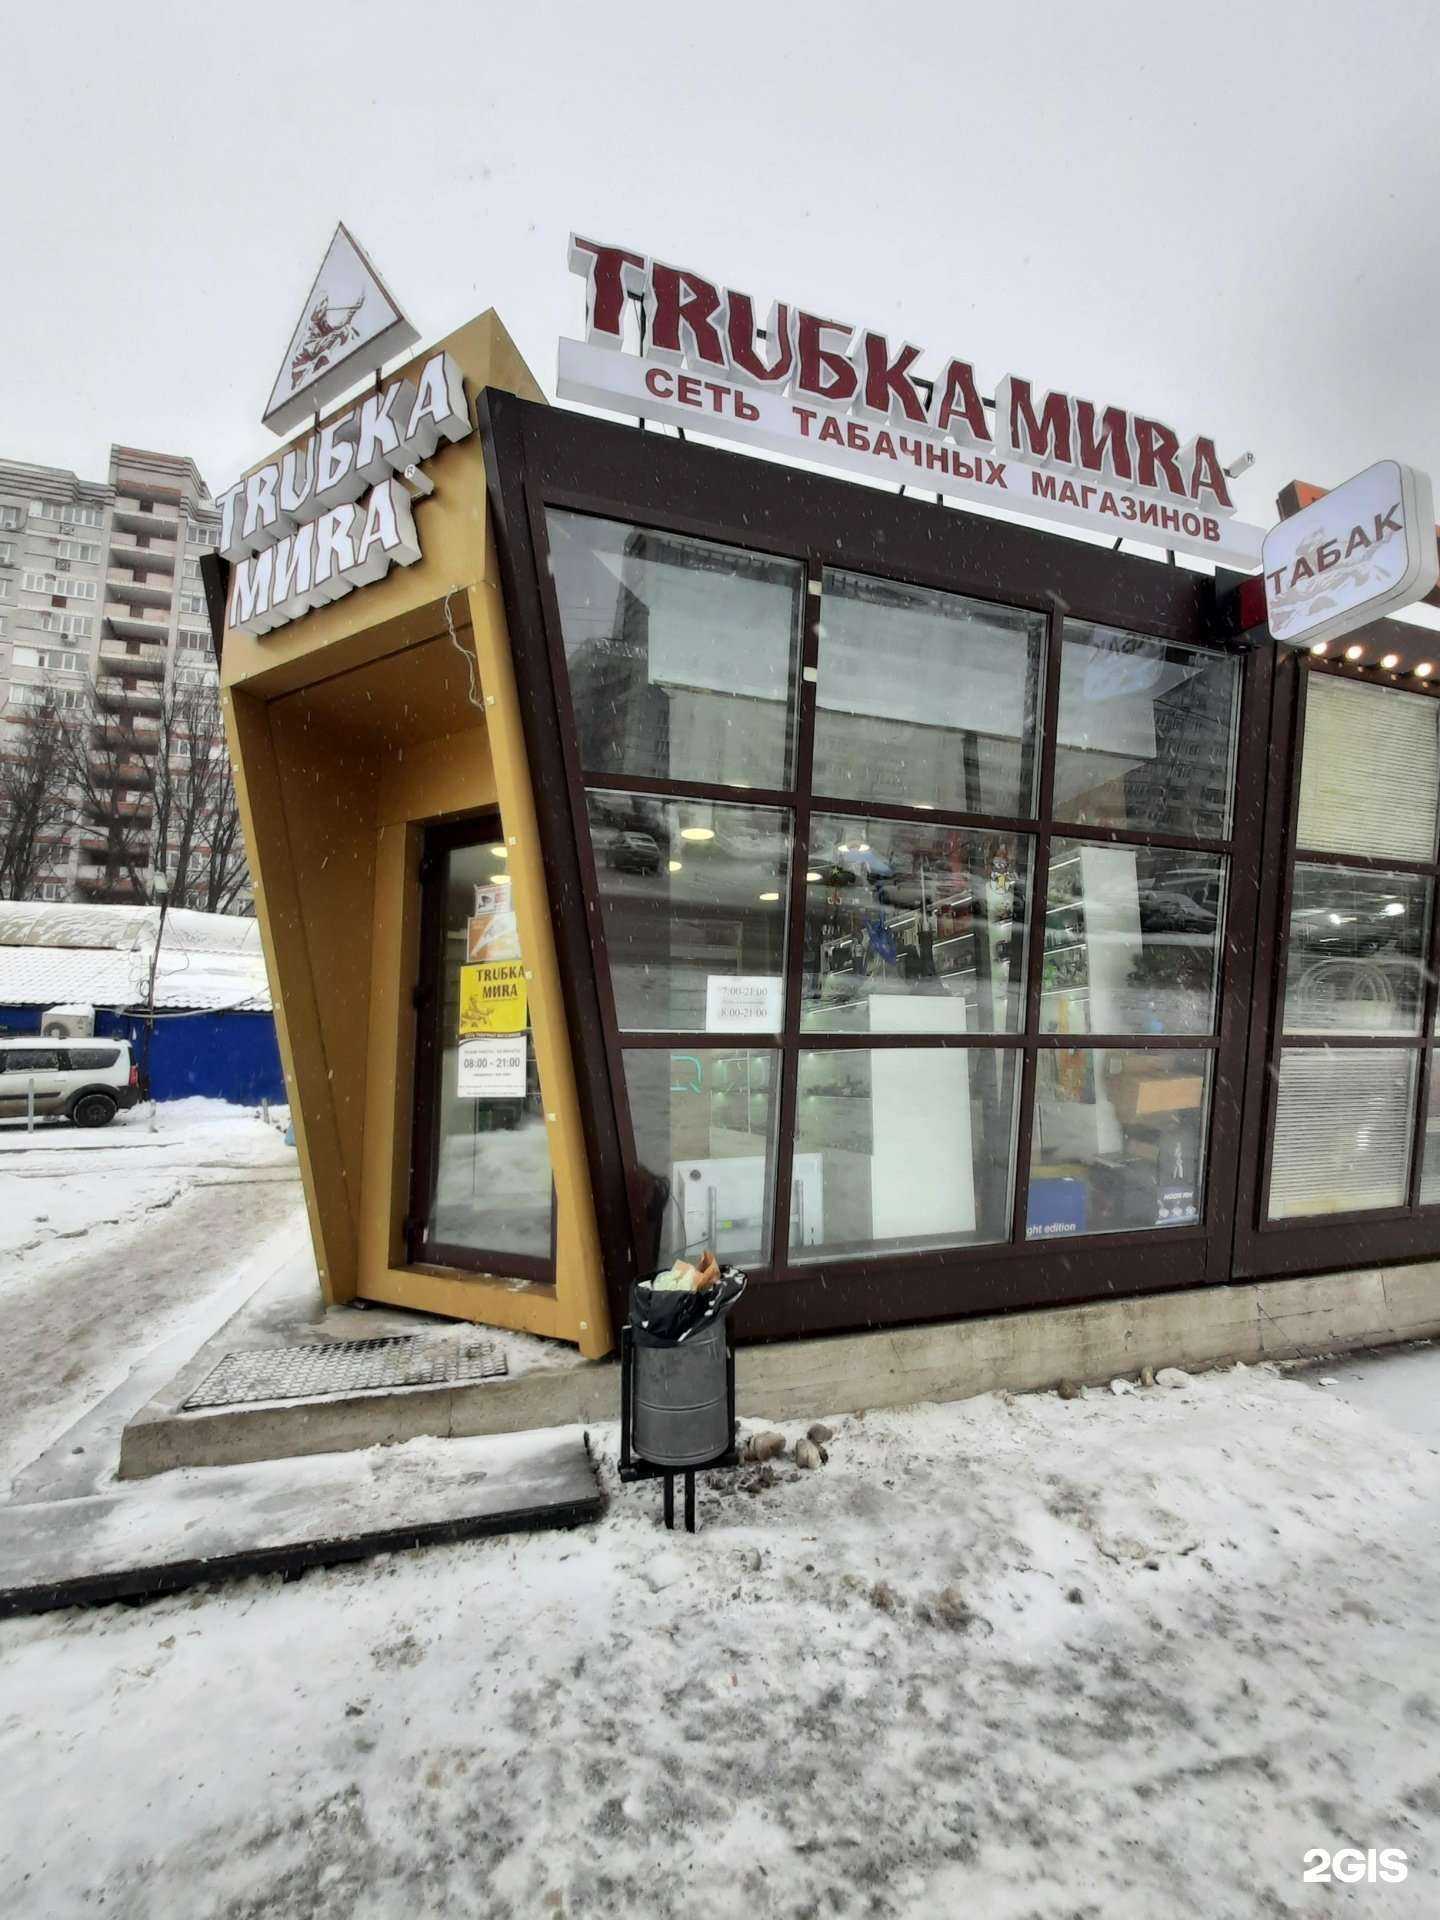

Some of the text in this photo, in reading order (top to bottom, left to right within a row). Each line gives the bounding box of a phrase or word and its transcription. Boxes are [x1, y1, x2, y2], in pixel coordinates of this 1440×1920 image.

[644, 366, 1222, 544] СЕТЬ ТАБАЧНЫХ МАГАЗИНОВ
[1266, 501, 1404, 596] ТАБАК
[495, 1056, 520, 1068] 21:00
[1043, 1222, 1077, 1234] edition
